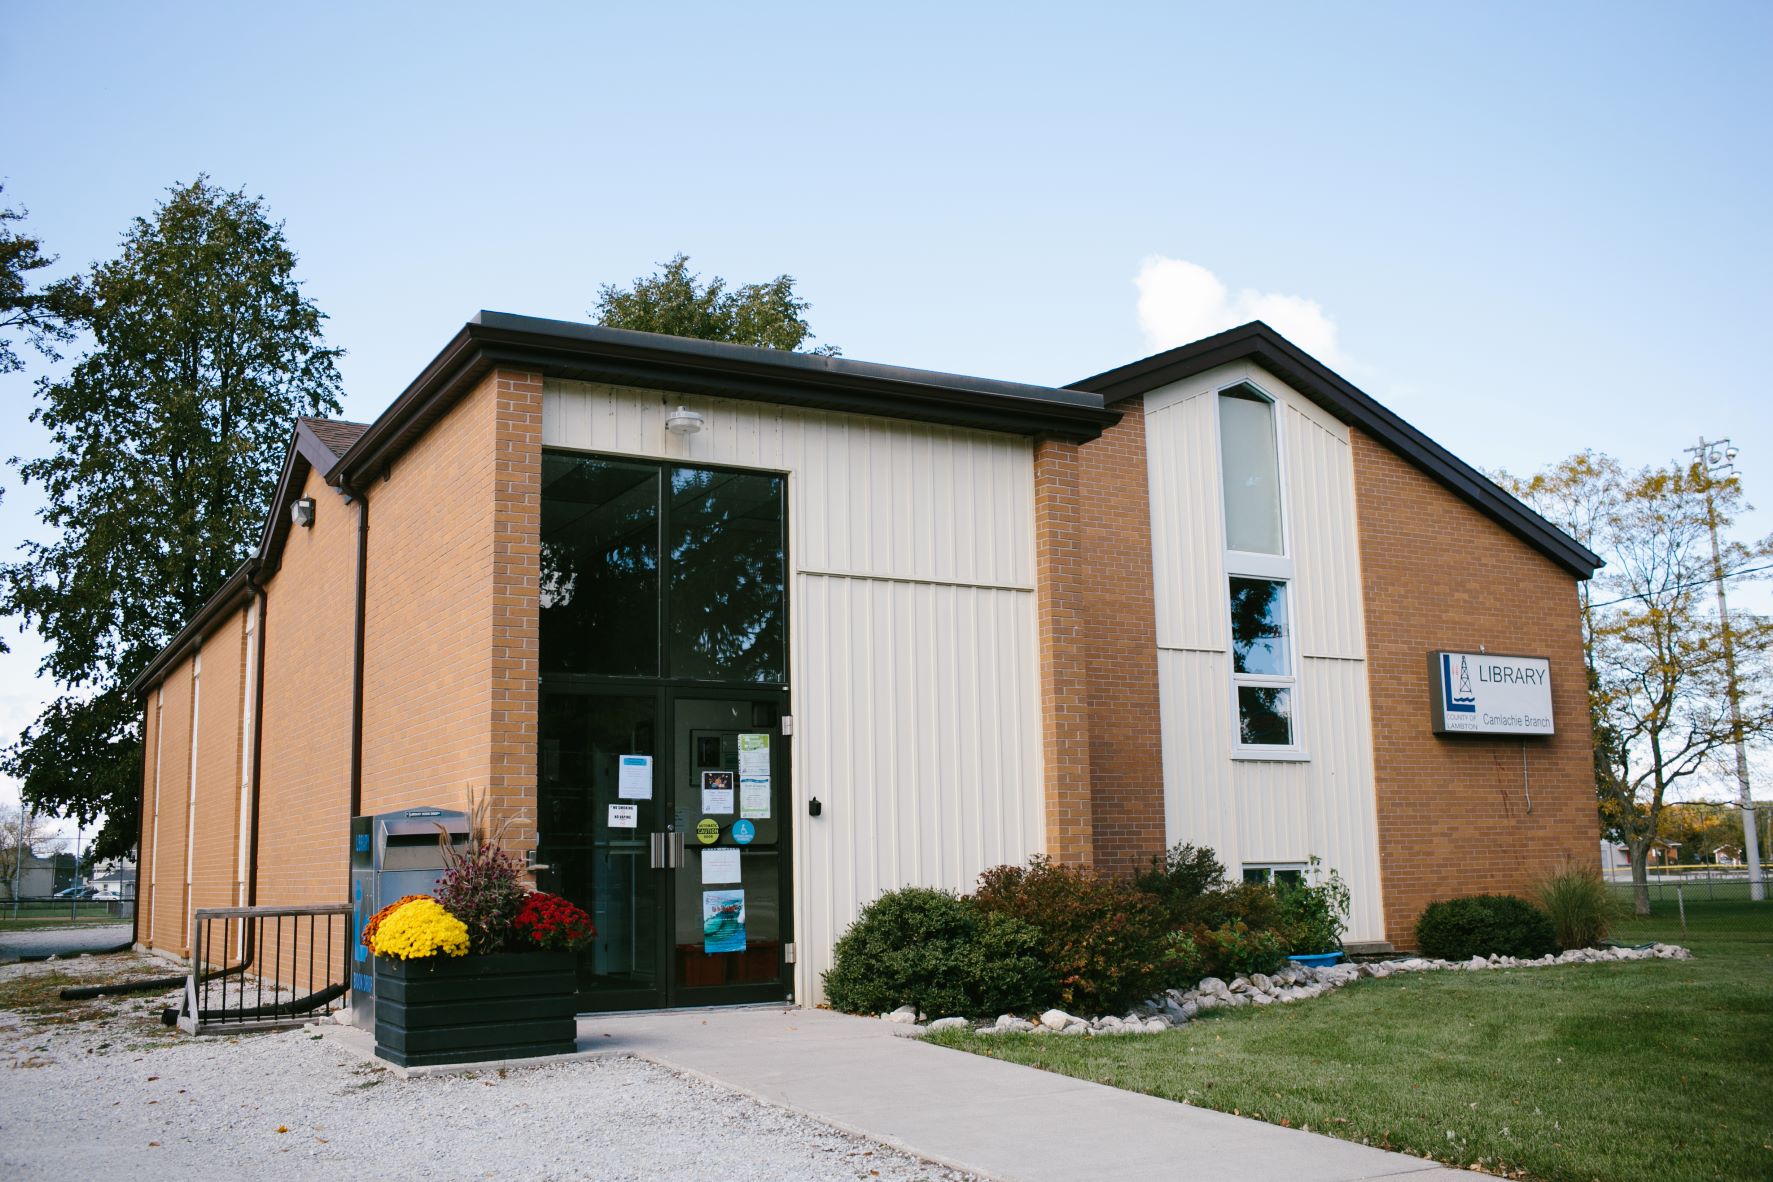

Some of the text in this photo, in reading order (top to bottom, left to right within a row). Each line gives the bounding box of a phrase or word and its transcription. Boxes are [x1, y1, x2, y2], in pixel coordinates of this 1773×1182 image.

[1479, 665, 1546, 685] LIBRARY
[1447, 722, 1478, 730] LAMBTON
[1482, 713, 1550, 728] Camlachie Branch
